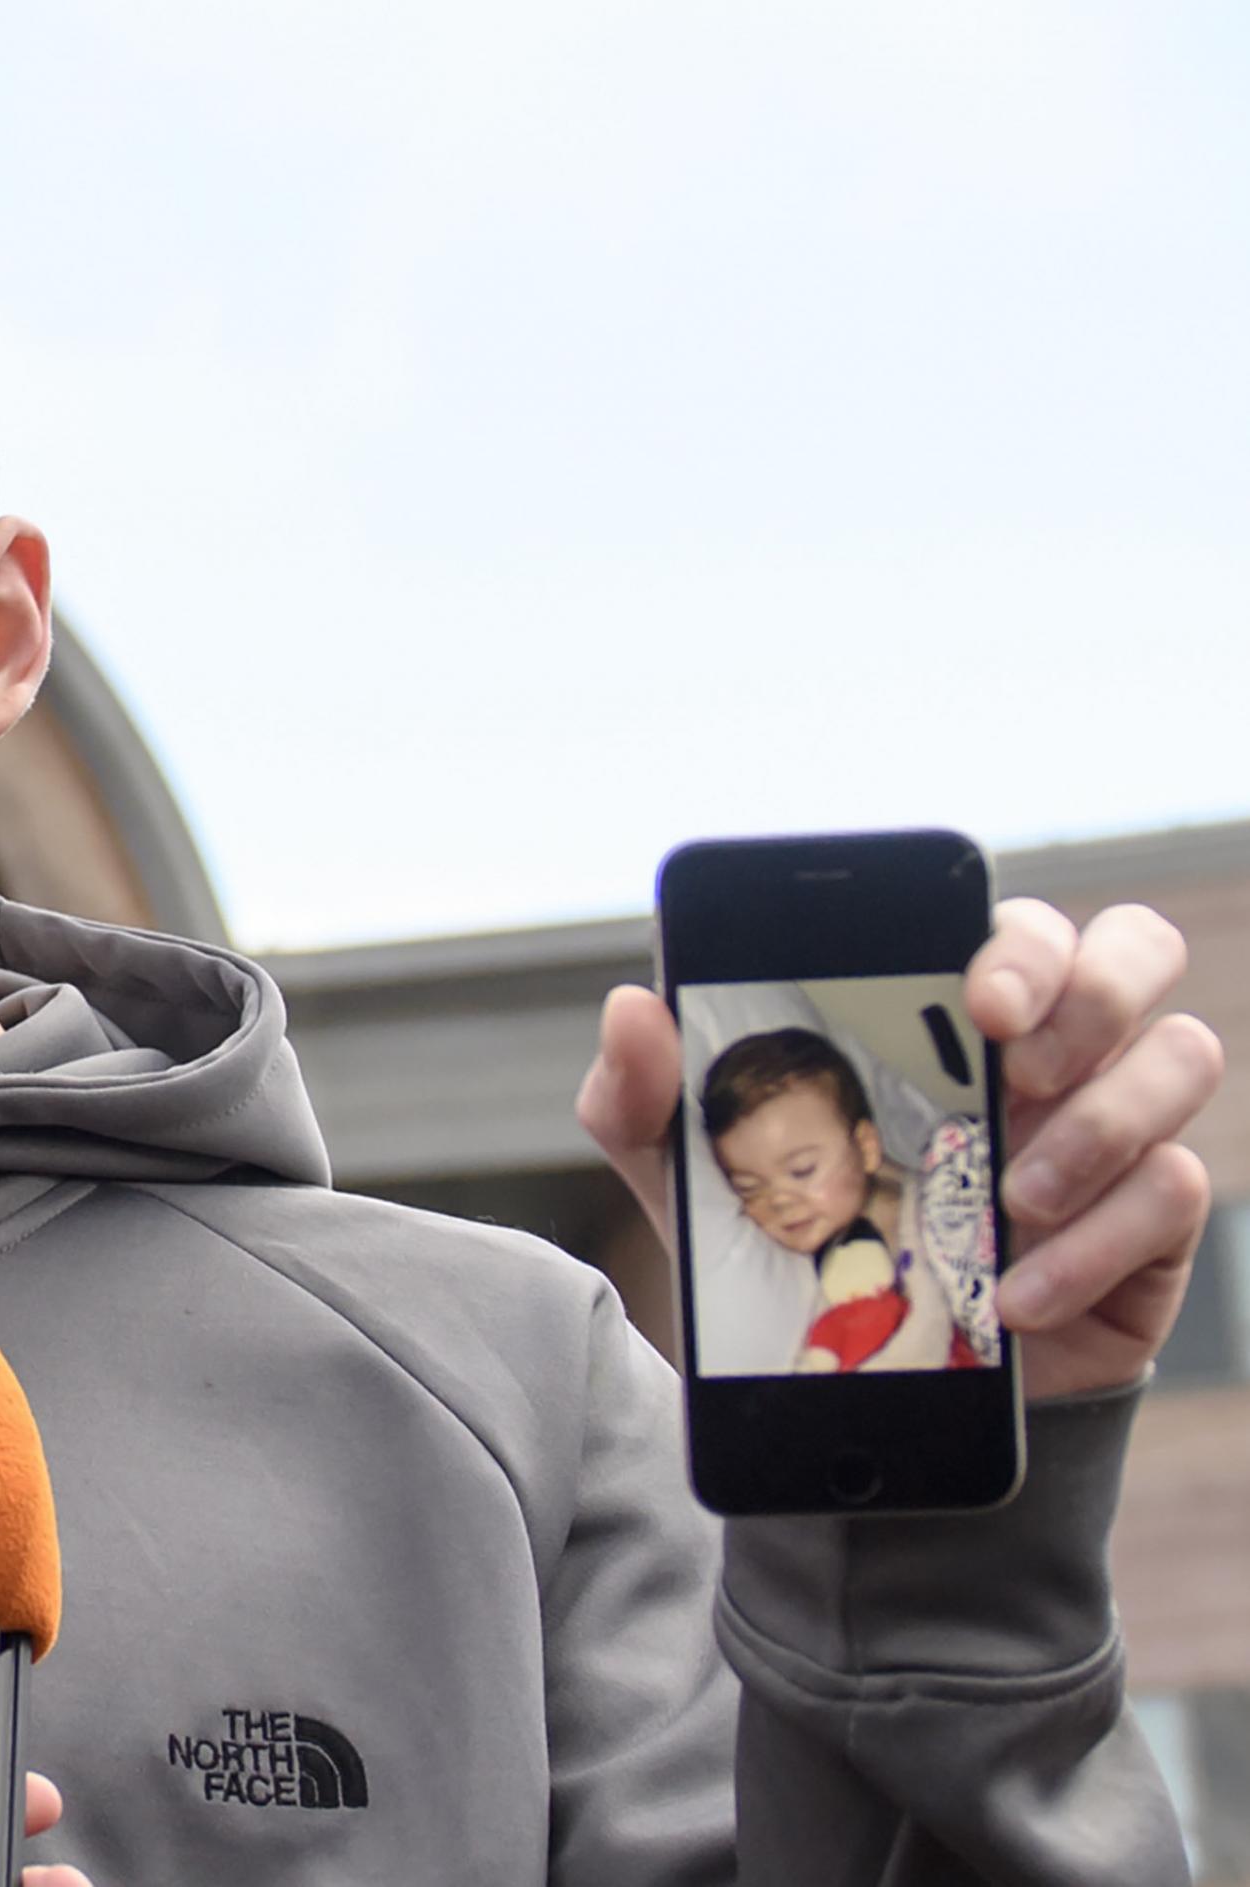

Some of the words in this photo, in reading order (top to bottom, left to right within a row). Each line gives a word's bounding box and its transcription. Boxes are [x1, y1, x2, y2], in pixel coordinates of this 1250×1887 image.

[222, 1709, 292, 1743] THE
[167, 1733, 295, 1774] NORTH
[204, 1772, 298, 1807] FACE
